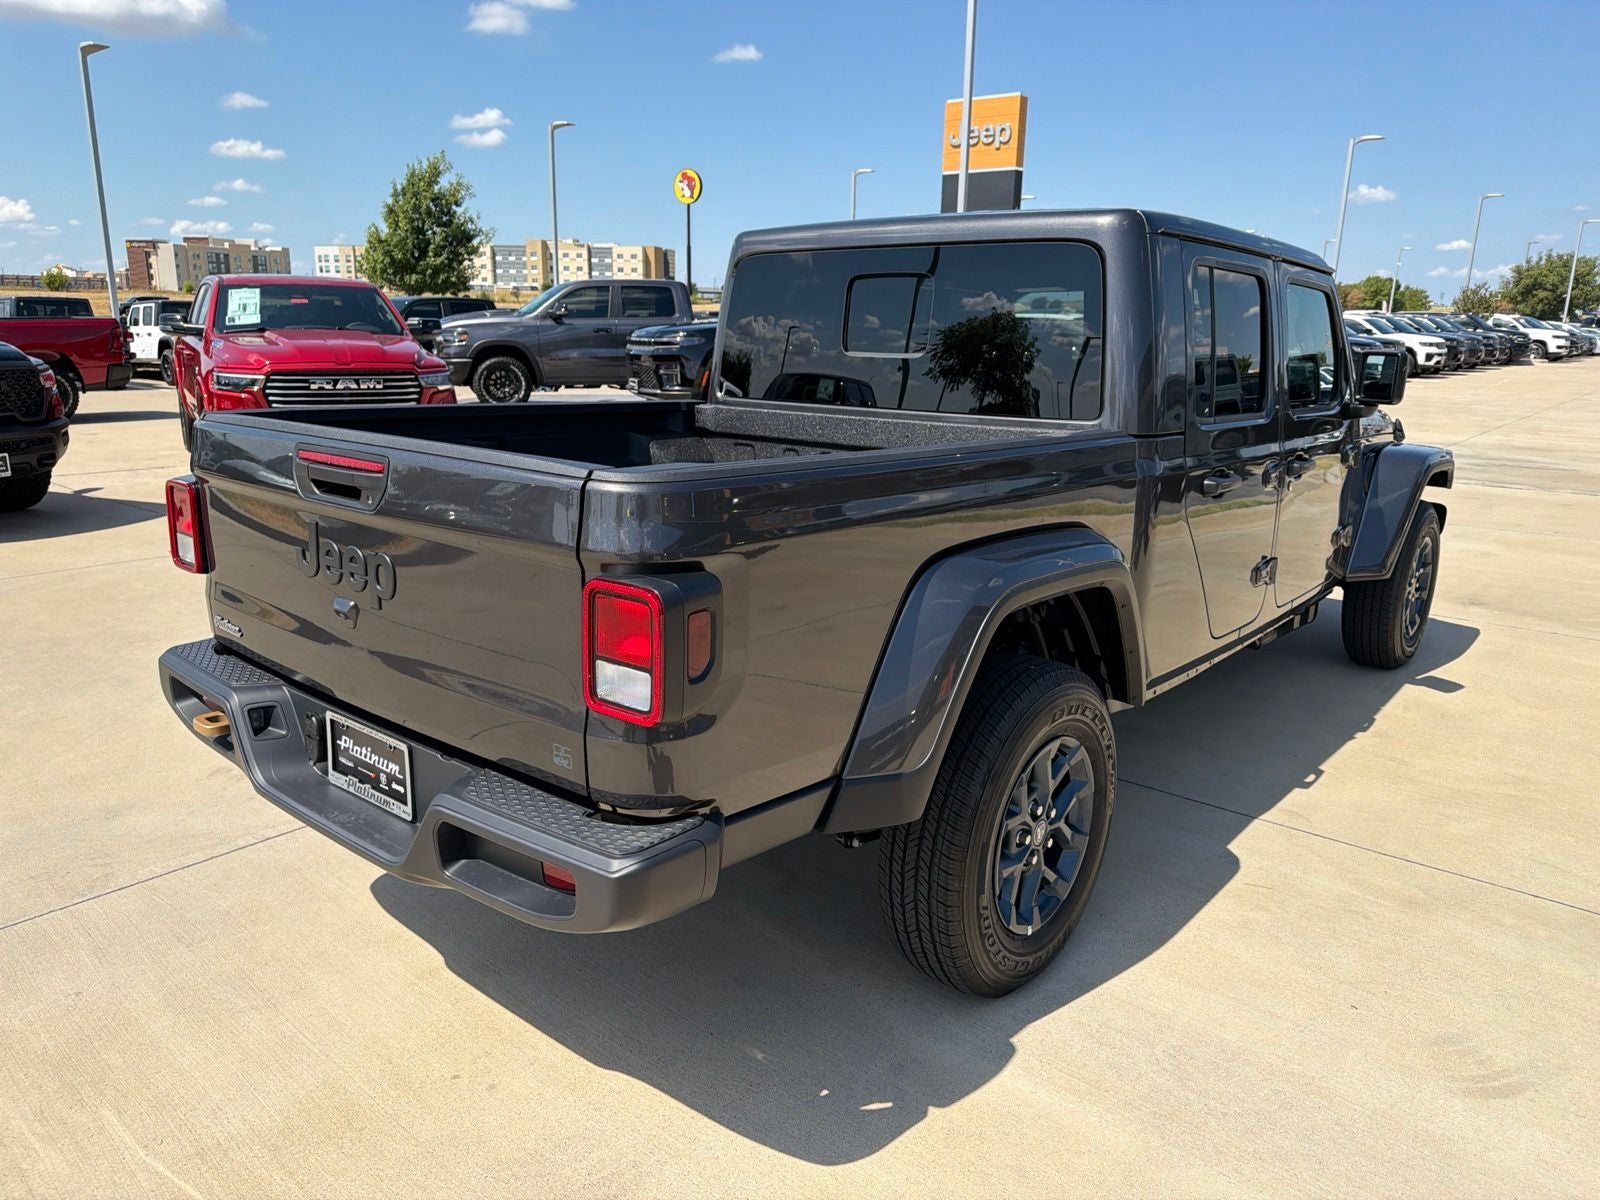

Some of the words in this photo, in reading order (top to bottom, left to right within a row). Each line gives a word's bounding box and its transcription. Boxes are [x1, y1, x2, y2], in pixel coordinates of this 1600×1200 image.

[309, 379, 384, 390] RAM
[295, 520, 397, 611] Jeep
[337, 735, 404, 779] Platinum
[346, 777, 396, 811] Platinum
